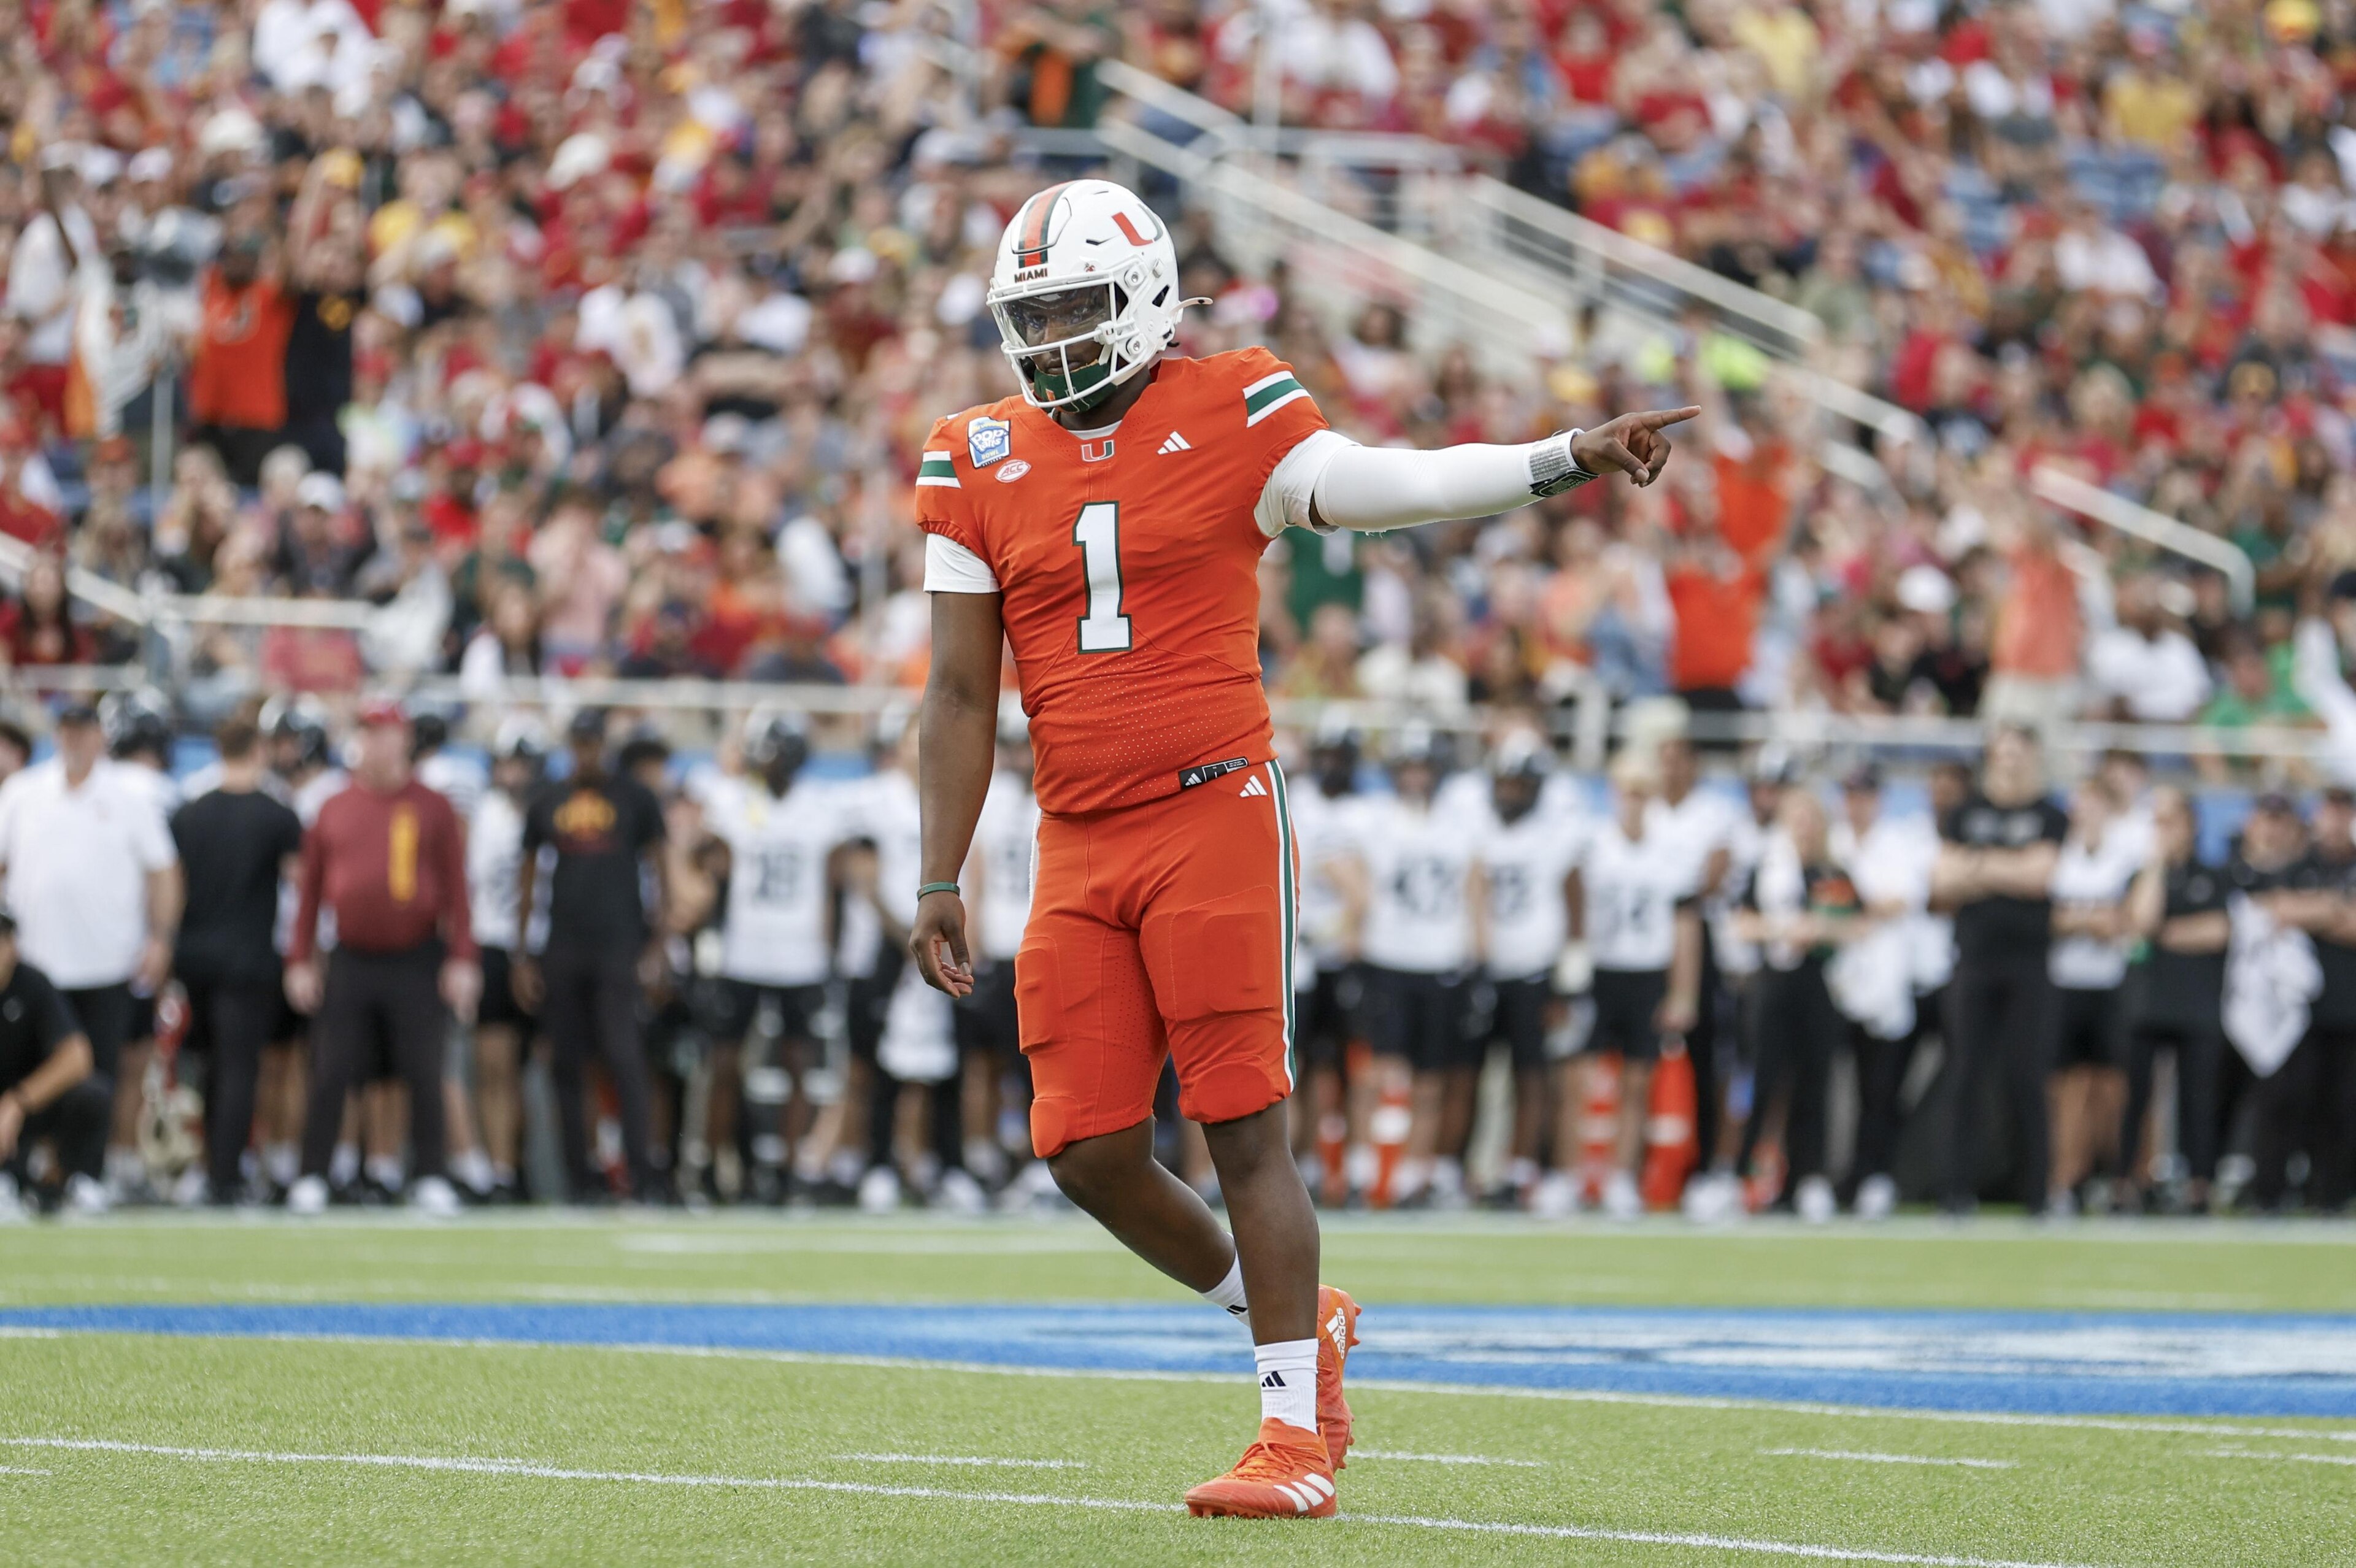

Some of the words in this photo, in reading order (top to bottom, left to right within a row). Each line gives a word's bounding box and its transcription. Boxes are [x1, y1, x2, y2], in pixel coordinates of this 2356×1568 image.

[1014, 267, 1048, 283] MIAMI
[1082, 440, 1114, 461] U
[1001, 463, 1024, 477] ACC
[1072, 501, 1132, 655] 1
[1336, 1307, 1346, 1359] adidas
